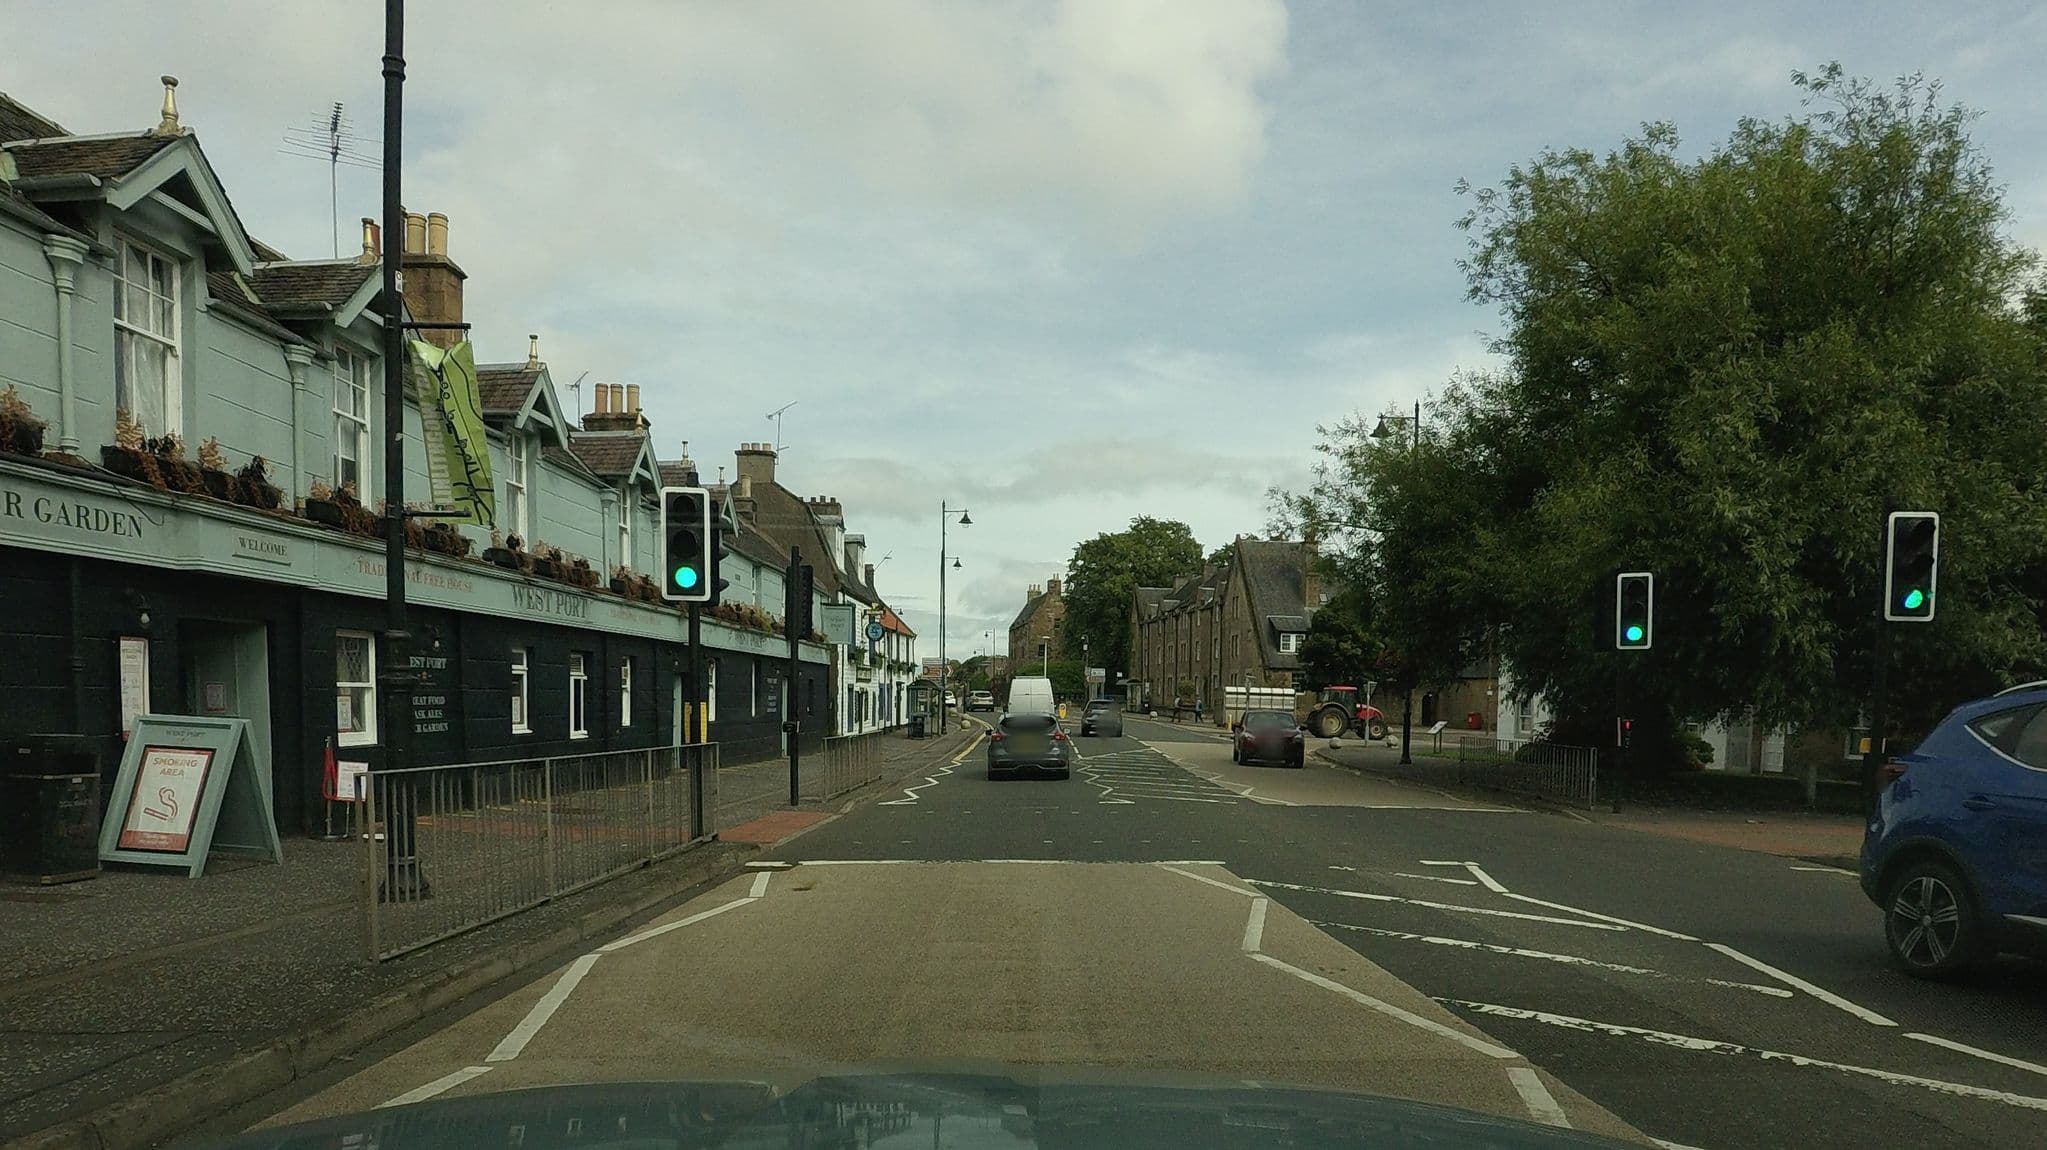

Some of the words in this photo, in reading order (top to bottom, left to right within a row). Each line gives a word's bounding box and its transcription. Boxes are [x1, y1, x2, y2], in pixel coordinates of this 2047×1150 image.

[34, 497, 143, 539] GARDEN
[238, 536, 288, 556] WELCOME
[512, 584, 552, 612] WEST
[555, 593, 589, 618] PORT
[409, 656, 425, 668] EST
[426, 656, 447, 669] PORT
[427, 695, 446, 705] FOOD
[414, 709, 426, 719] ASK
[427, 709, 443, 719] ALES
[422, 722, 448, 733] GARDEN
[152, 757, 198, 768] SMOKING
[159, 768, 185, 777] AREA
